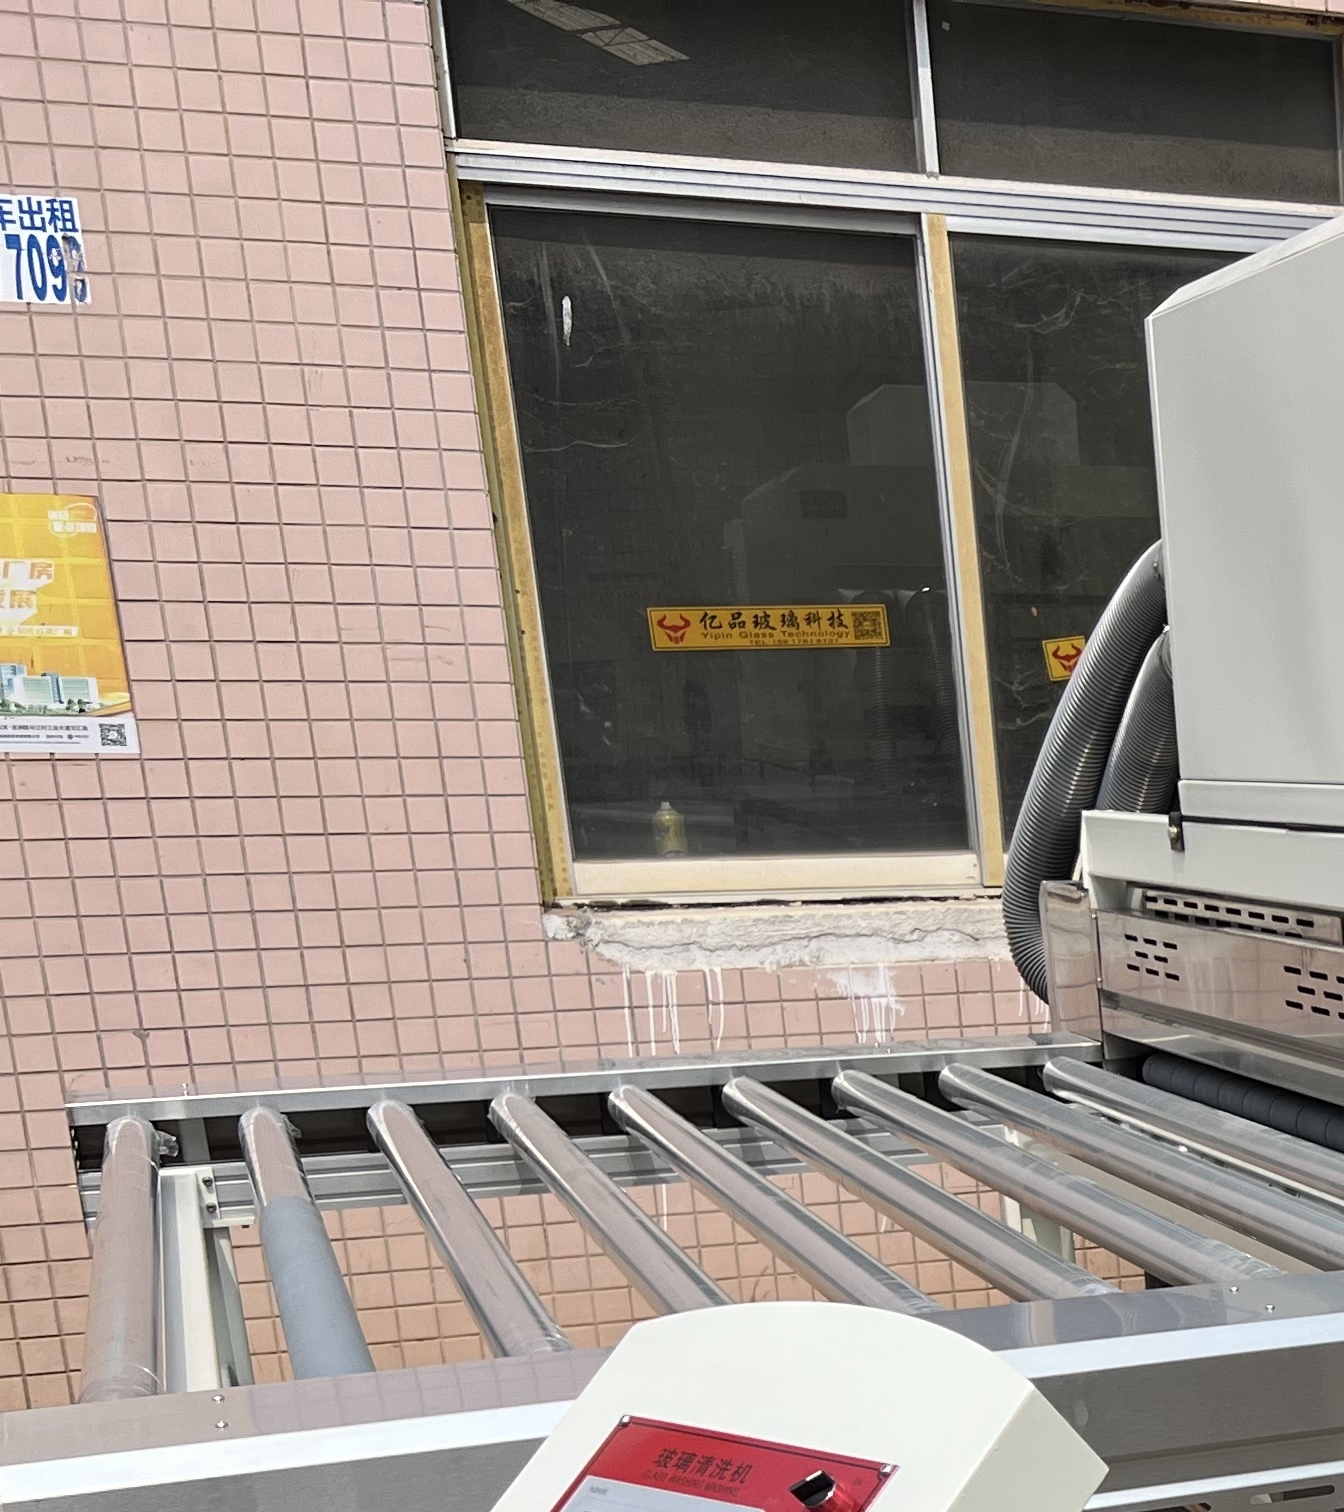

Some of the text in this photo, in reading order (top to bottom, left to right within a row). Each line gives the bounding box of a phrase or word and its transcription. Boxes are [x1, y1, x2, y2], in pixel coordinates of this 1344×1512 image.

[699, 609, 849, 632] 亿品玻璃科技
[701, 629, 851, 640] Yipin Glass Technology
[653, 1448, 753, 1484] 玻璃清洗机
